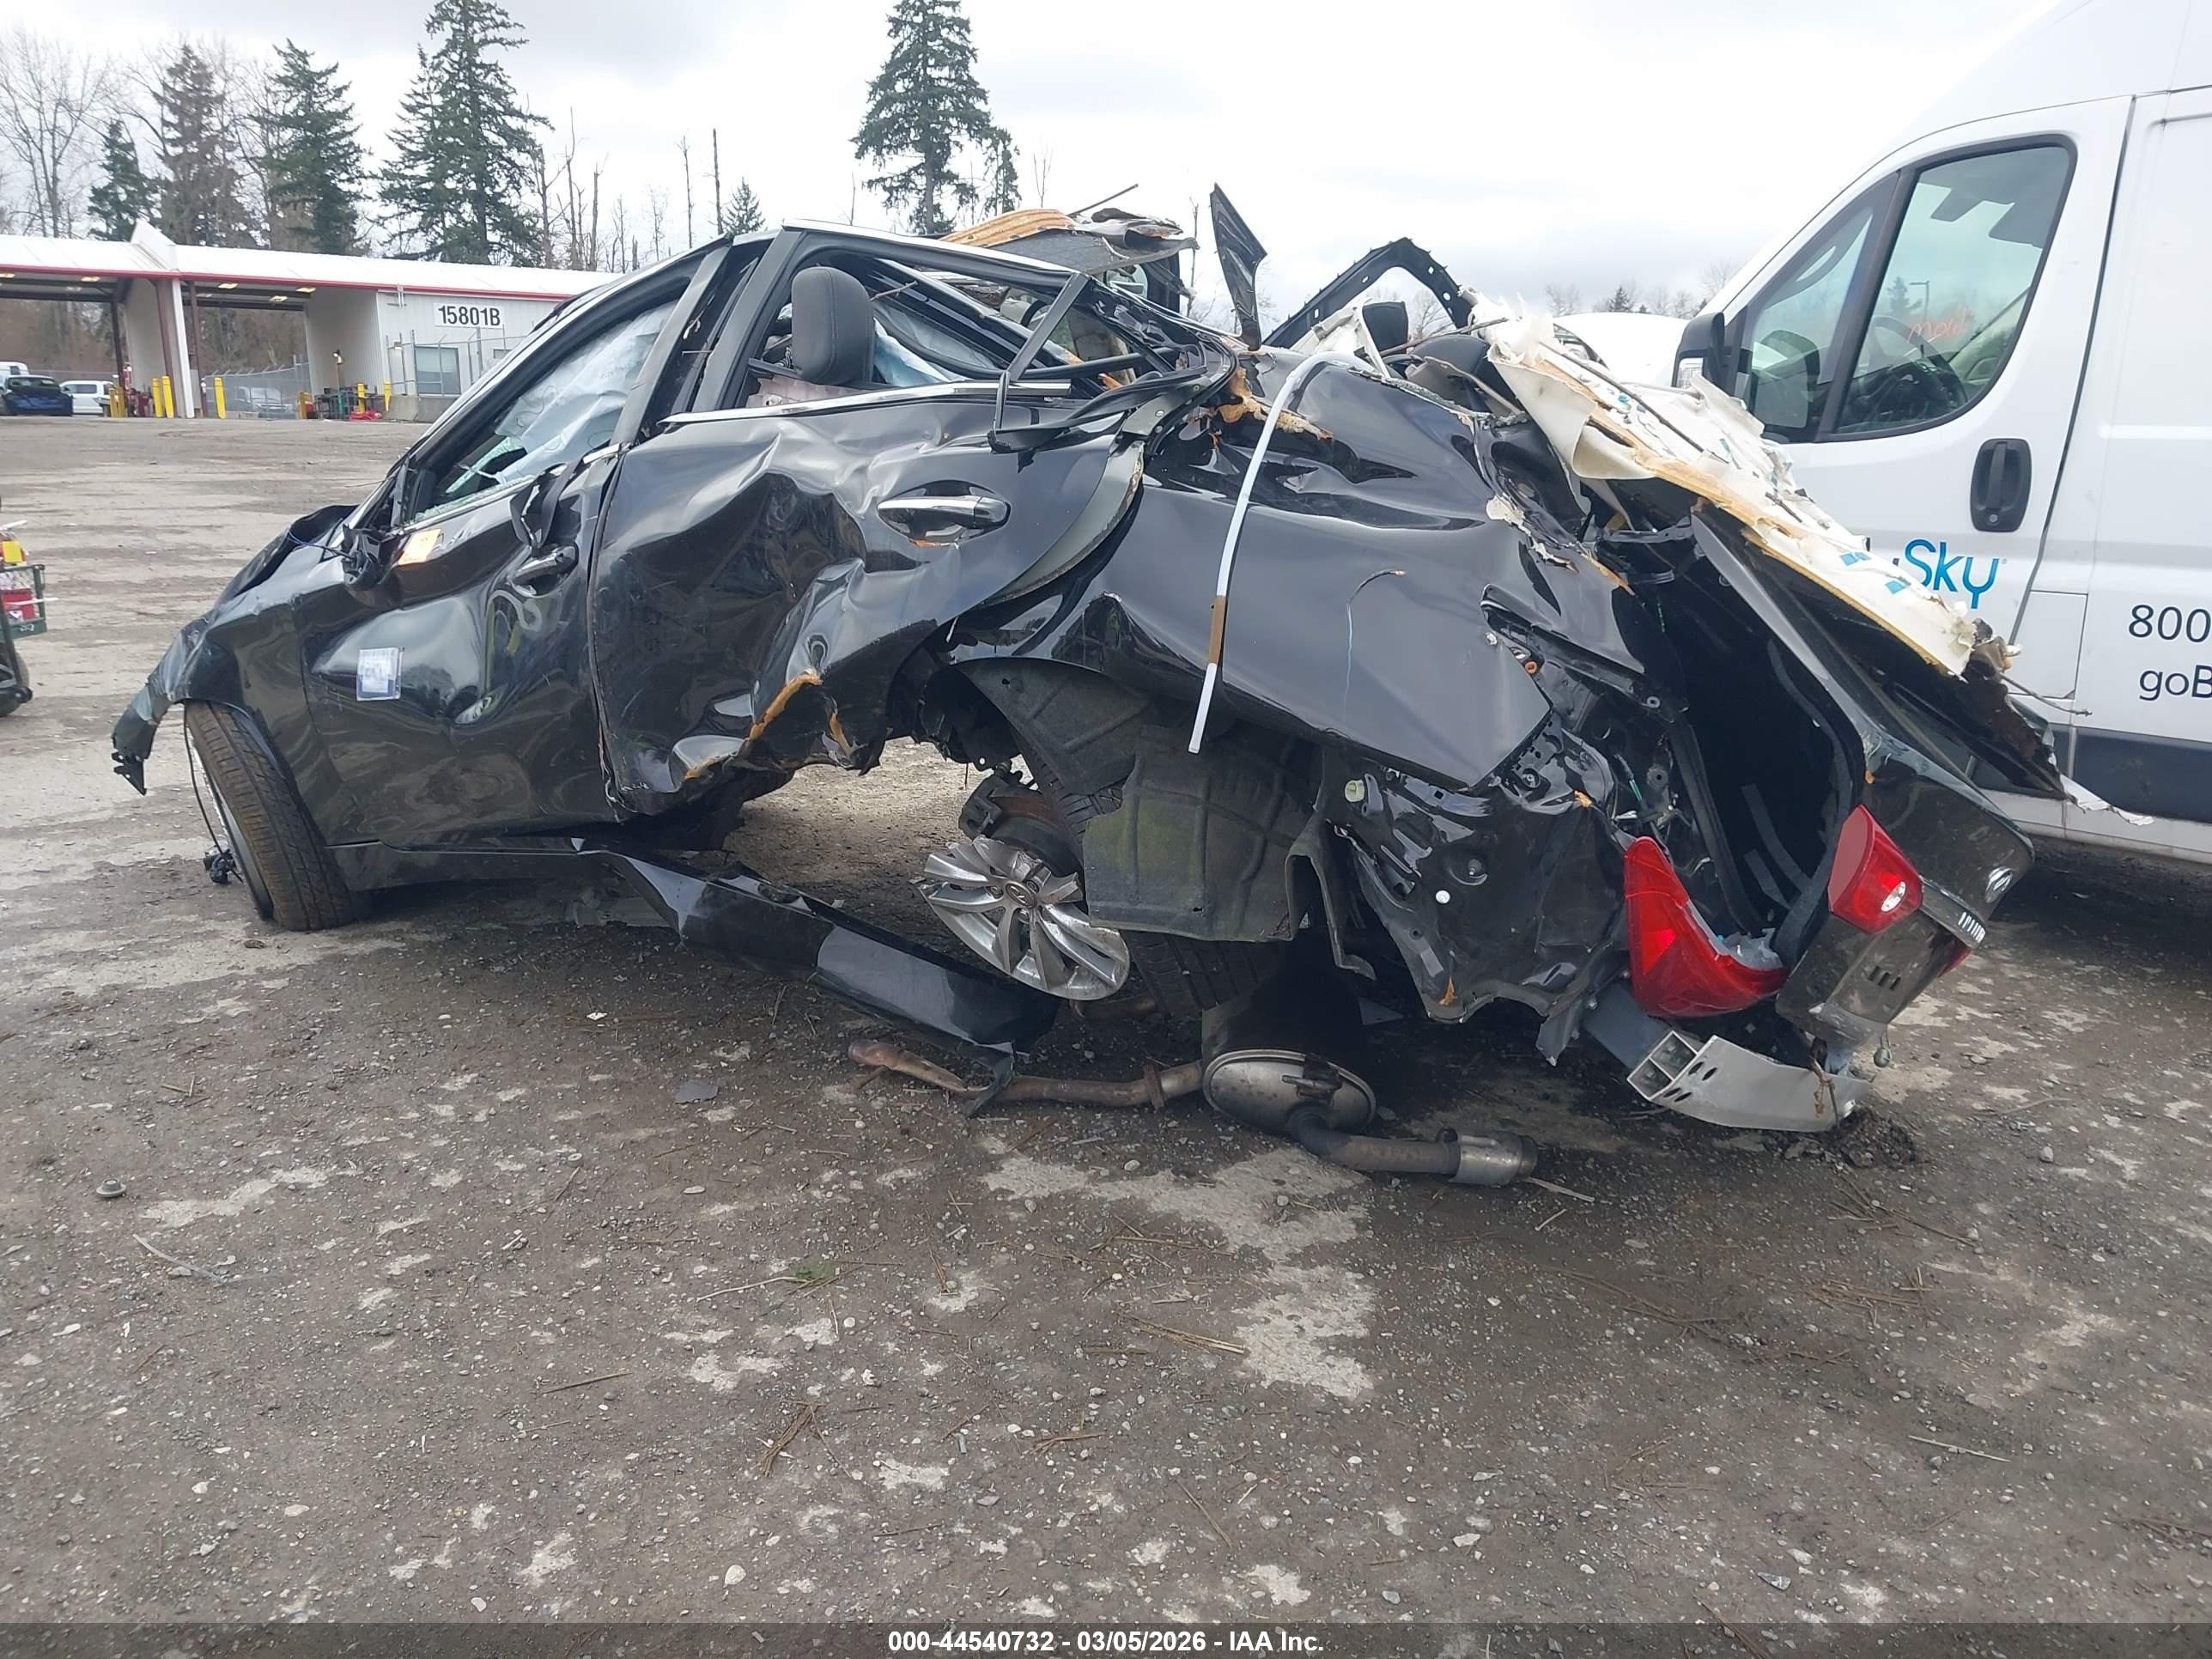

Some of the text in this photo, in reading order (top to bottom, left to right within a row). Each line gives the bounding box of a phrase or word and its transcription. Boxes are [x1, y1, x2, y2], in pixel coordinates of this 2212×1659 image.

[438, 305, 501, 326] 15801B
[1893, 538, 2000, 610] Sky
[2128, 604, 2212, 643] 800
[2139, 664, 2212, 702] goB
